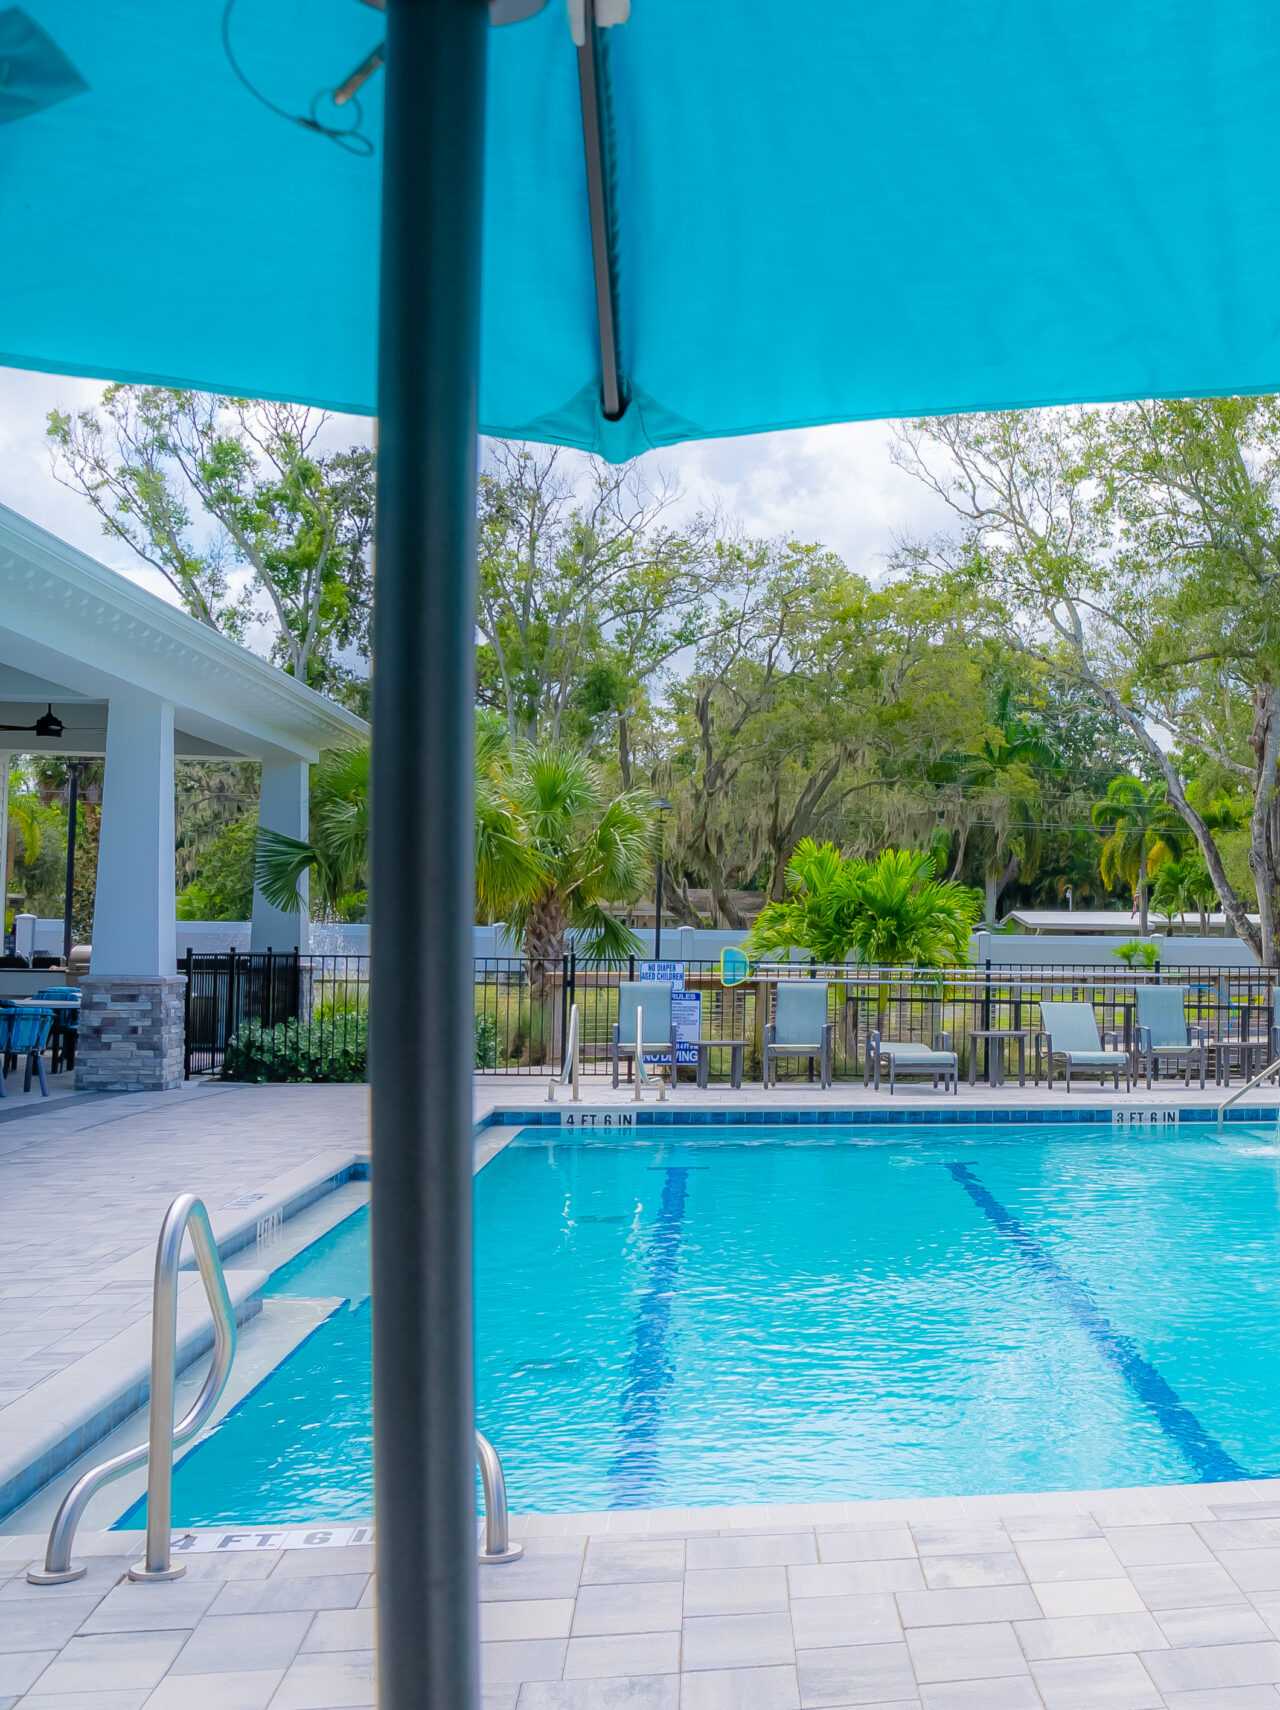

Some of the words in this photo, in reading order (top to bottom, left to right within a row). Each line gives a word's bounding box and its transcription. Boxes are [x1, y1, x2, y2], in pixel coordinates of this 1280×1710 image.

[648, 963, 656, 971] NO
[657, 963, 676, 971] DIAPER
[641, 972, 655, 980] AGED
[656, 972, 684, 980] CHILDREN
[566, 1114, 575, 1126] 4
[581, 1114, 597, 1126] FT
[603, 1114, 612, 1126] 6
[618, 1114, 632, 1126] IN
[1116, 1112, 1124, 1123] 3
[1130, 1112, 1144, 1123] FT
[1150, 1111, 1158, 1123] 6
[1163, 1111, 1176, 1123] IN
[170, 1535, 198, 1550] 4
[302, 1531, 333, 1545] 6
